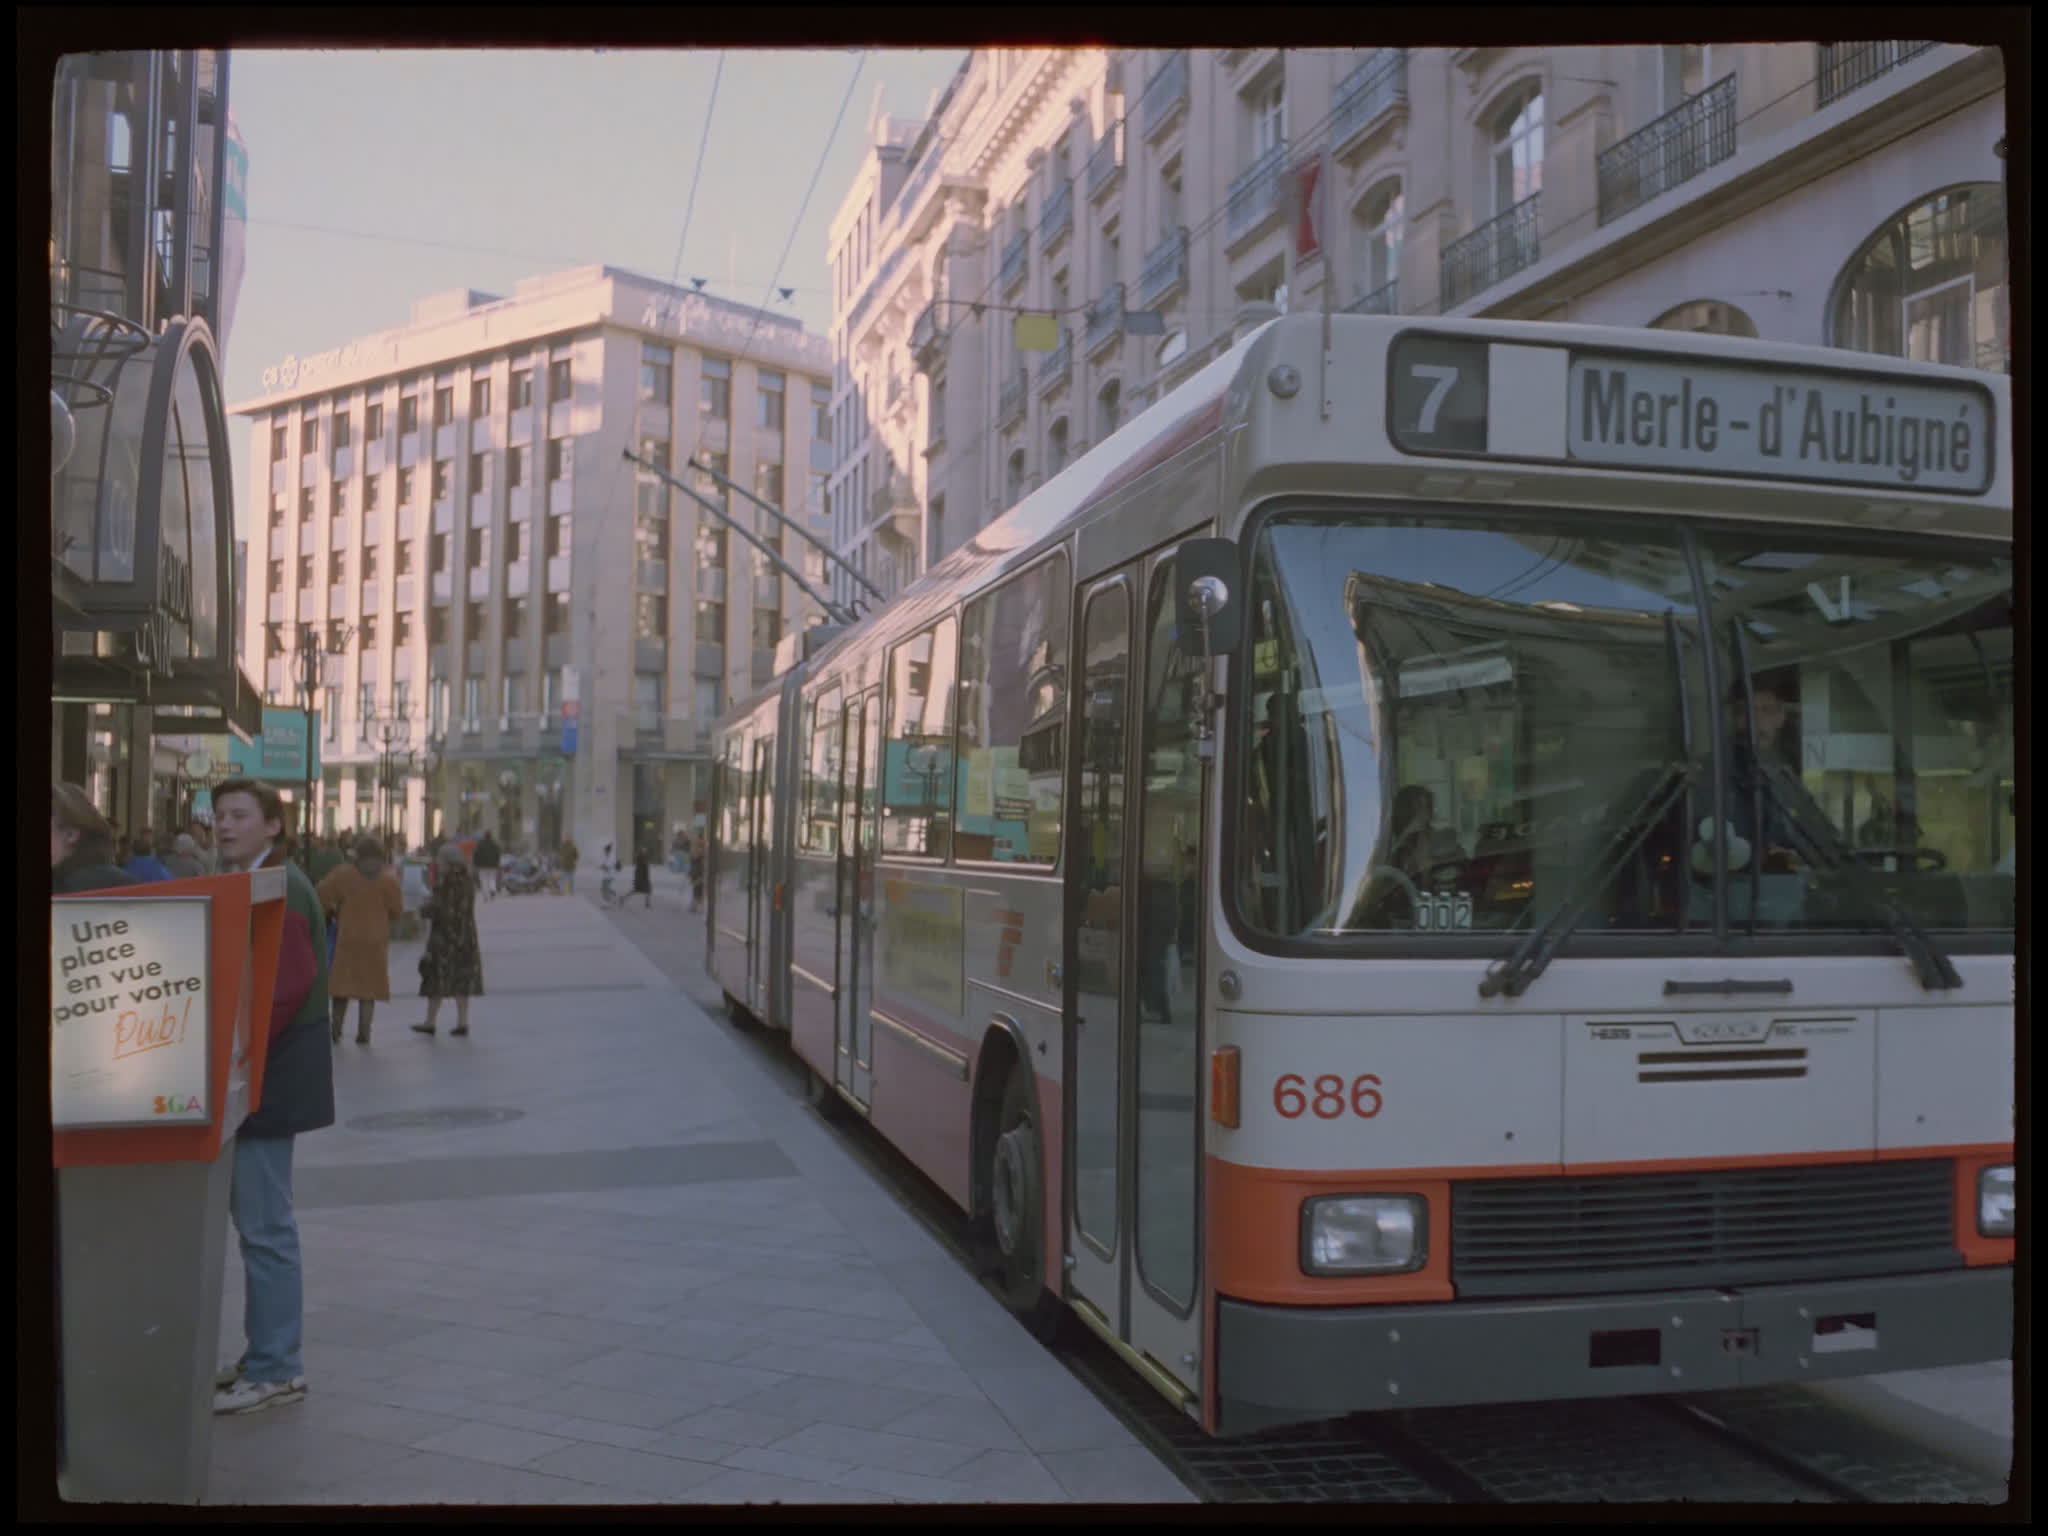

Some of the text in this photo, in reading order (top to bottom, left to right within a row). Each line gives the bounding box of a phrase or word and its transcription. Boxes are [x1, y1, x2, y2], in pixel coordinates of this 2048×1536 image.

[1411, 363, 1459, 433] 7
[72, 920, 128, 943] Une
[60, 943, 136, 977] place
[67, 961, 162, 994] en vue
[54, 976, 201, 1026] pour votre
[113, 997, 192, 1058] Pub!
[153, 1095, 203, 1114] SGA
[1273, 1073, 1382, 1119] 686
